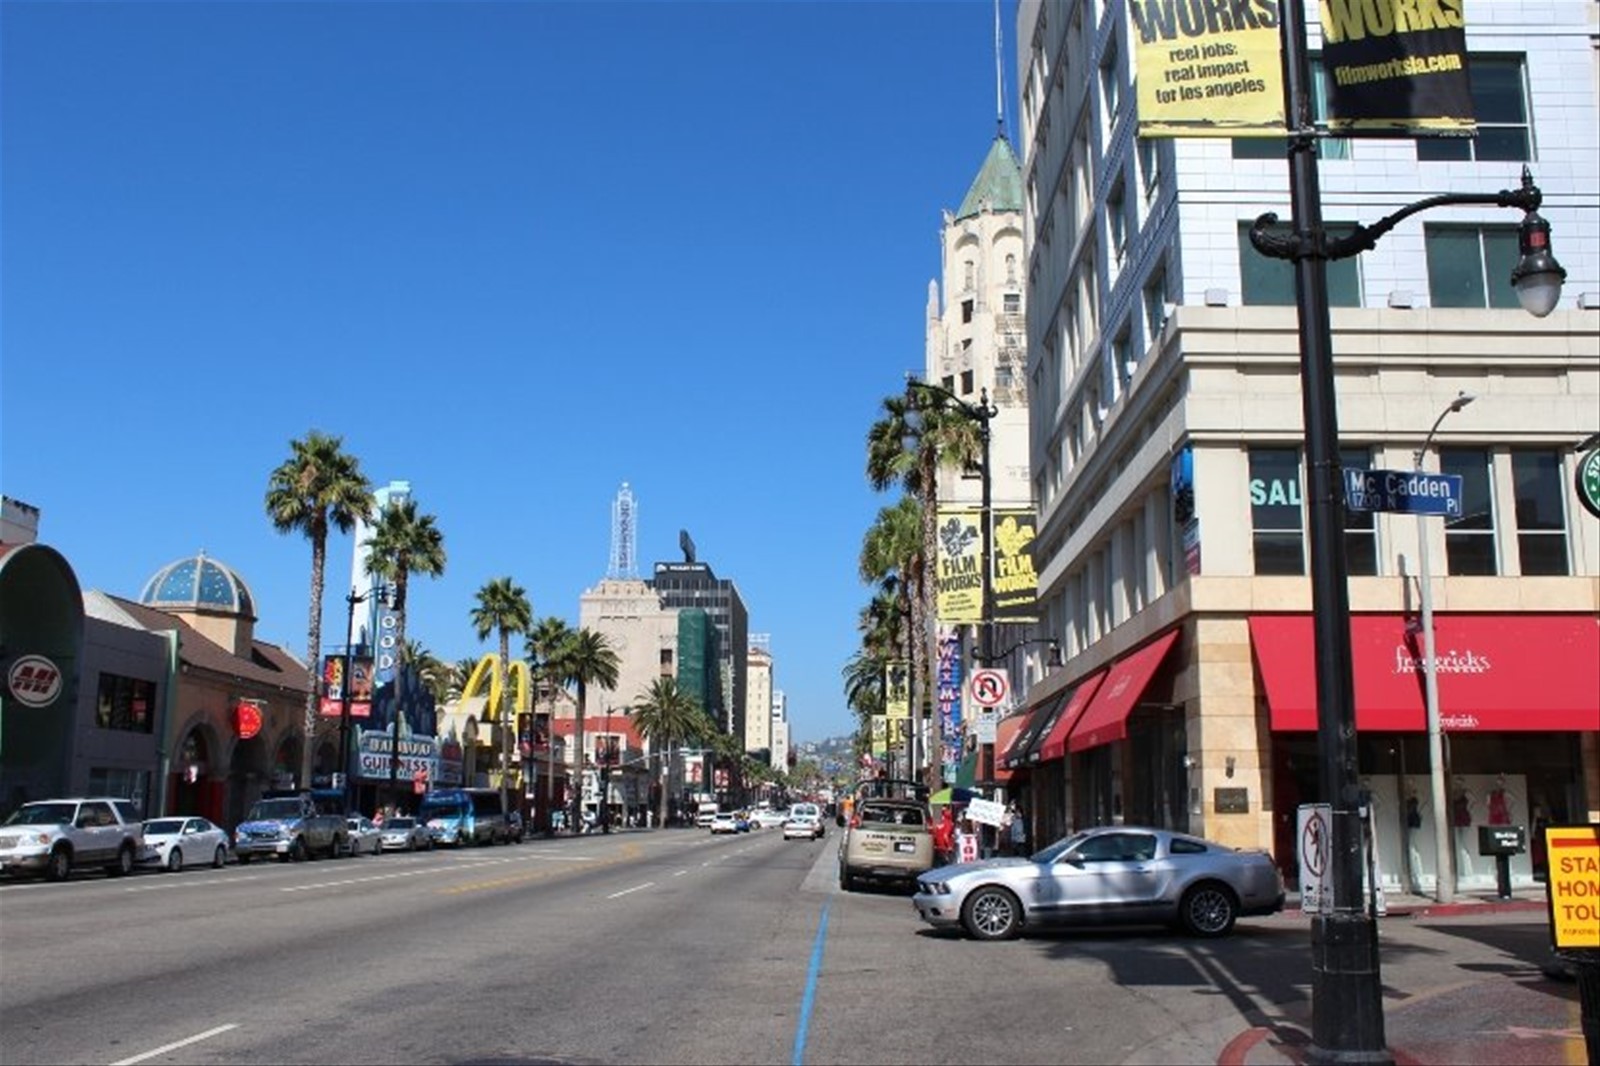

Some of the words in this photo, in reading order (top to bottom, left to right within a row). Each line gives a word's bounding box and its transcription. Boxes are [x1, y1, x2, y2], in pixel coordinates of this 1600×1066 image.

[1129, 0, 1279, 44] WORKS
[1319, 0, 1463, 44] WORKS
[1169, 45, 1200, 63] reel
[1202, 43, 1238, 60] jobs:
[1164, 64, 1196, 83] real
[1196, 60, 1250, 79] impact
[1335, 54, 1462, 86] filmworksla.com
[1155, 88, 1177, 104] for
[1179, 85, 1203, 101] los
[1205, 79, 1265, 97] angeles
[1350, 471, 1376, 493] Mc
[1385, 473, 1450, 498] Cadden
[1447, 498, 1459, 513] Pl
[942, 554, 976, 576] FILM
[998, 554, 1034, 578] FILM
[937, 573, 981, 594] WORKS
[994, 573, 1038, 594] WORKS
[1561, 857, 1598, 873] STA
